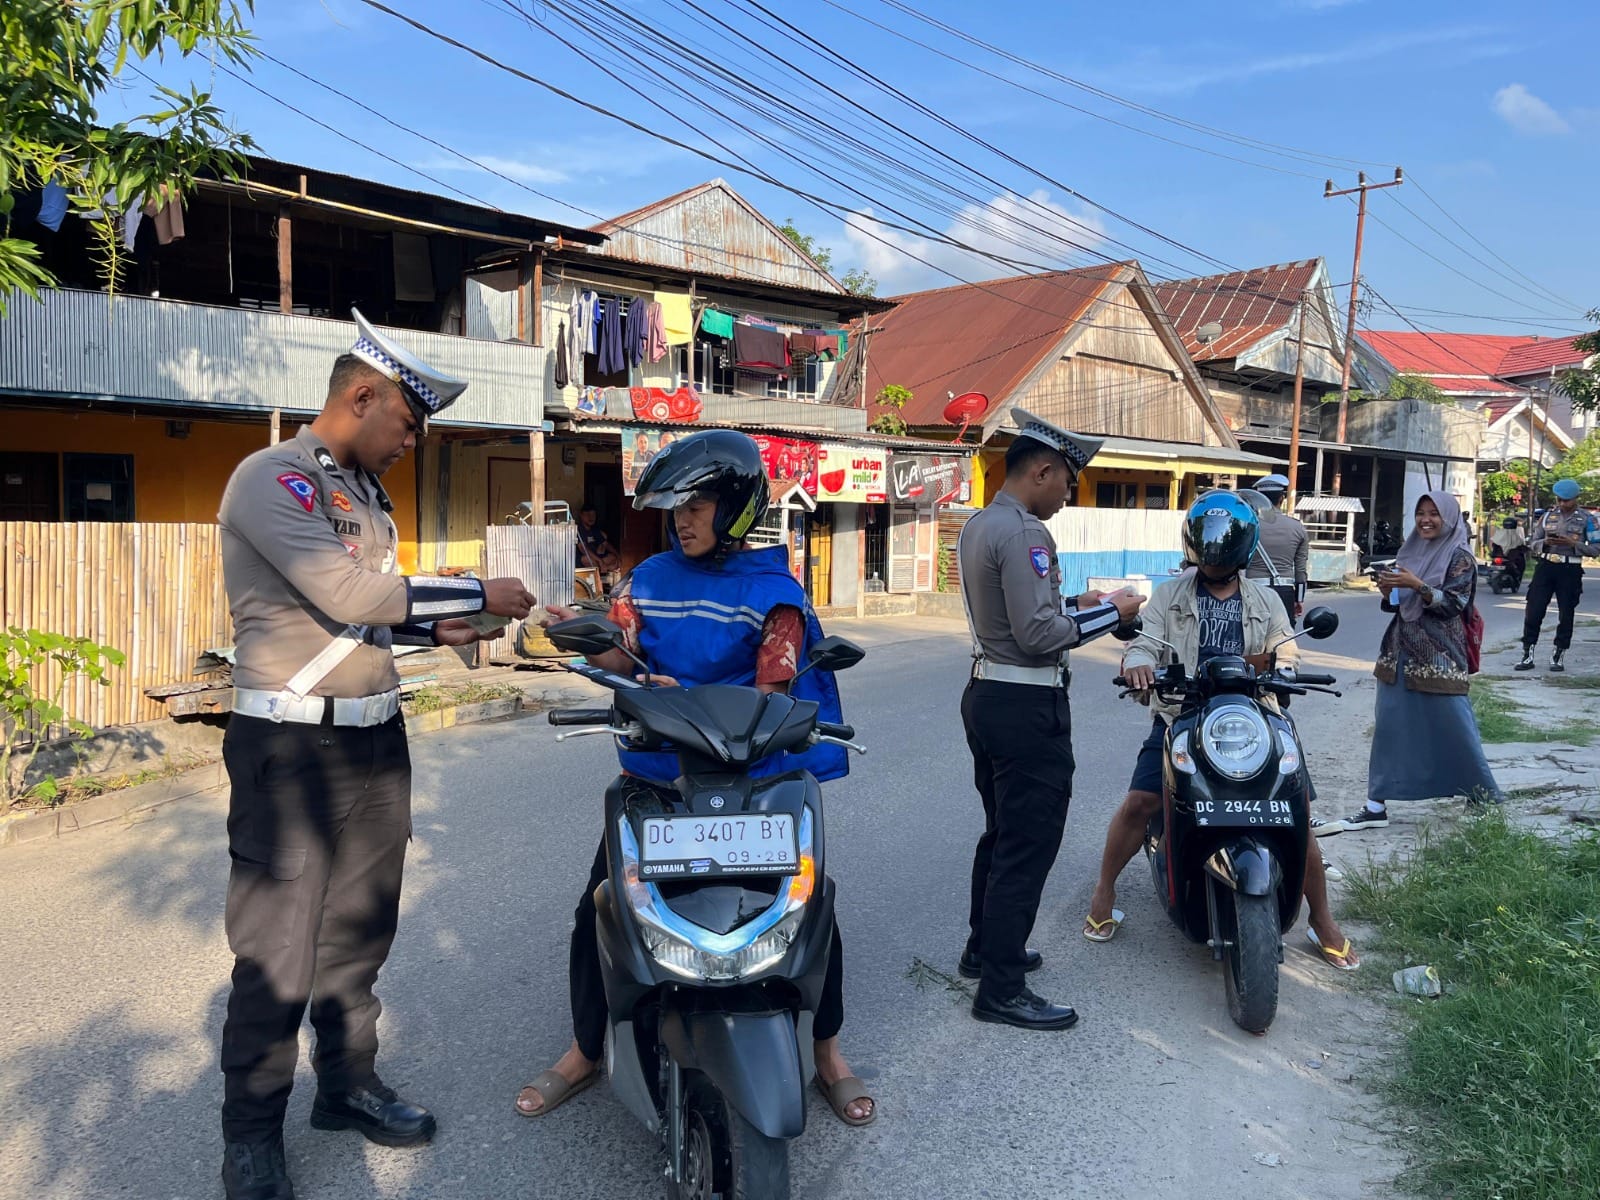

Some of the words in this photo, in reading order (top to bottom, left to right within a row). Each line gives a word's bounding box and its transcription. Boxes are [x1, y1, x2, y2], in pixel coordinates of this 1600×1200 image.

[852, 457, 882, 471] urban
[853, 471, 872, 483] mild
[1196, 801, 1215, 813] DC
[1225, 801, 1262, 813] 2944
[1270, 801, 1291, 813] BN
[650, 824, 674, 844] DC
[694, 821, 746, 843] 3407
[761, 820, 786, 840] BY
[653, 864, 685, 873] YAMAHA
